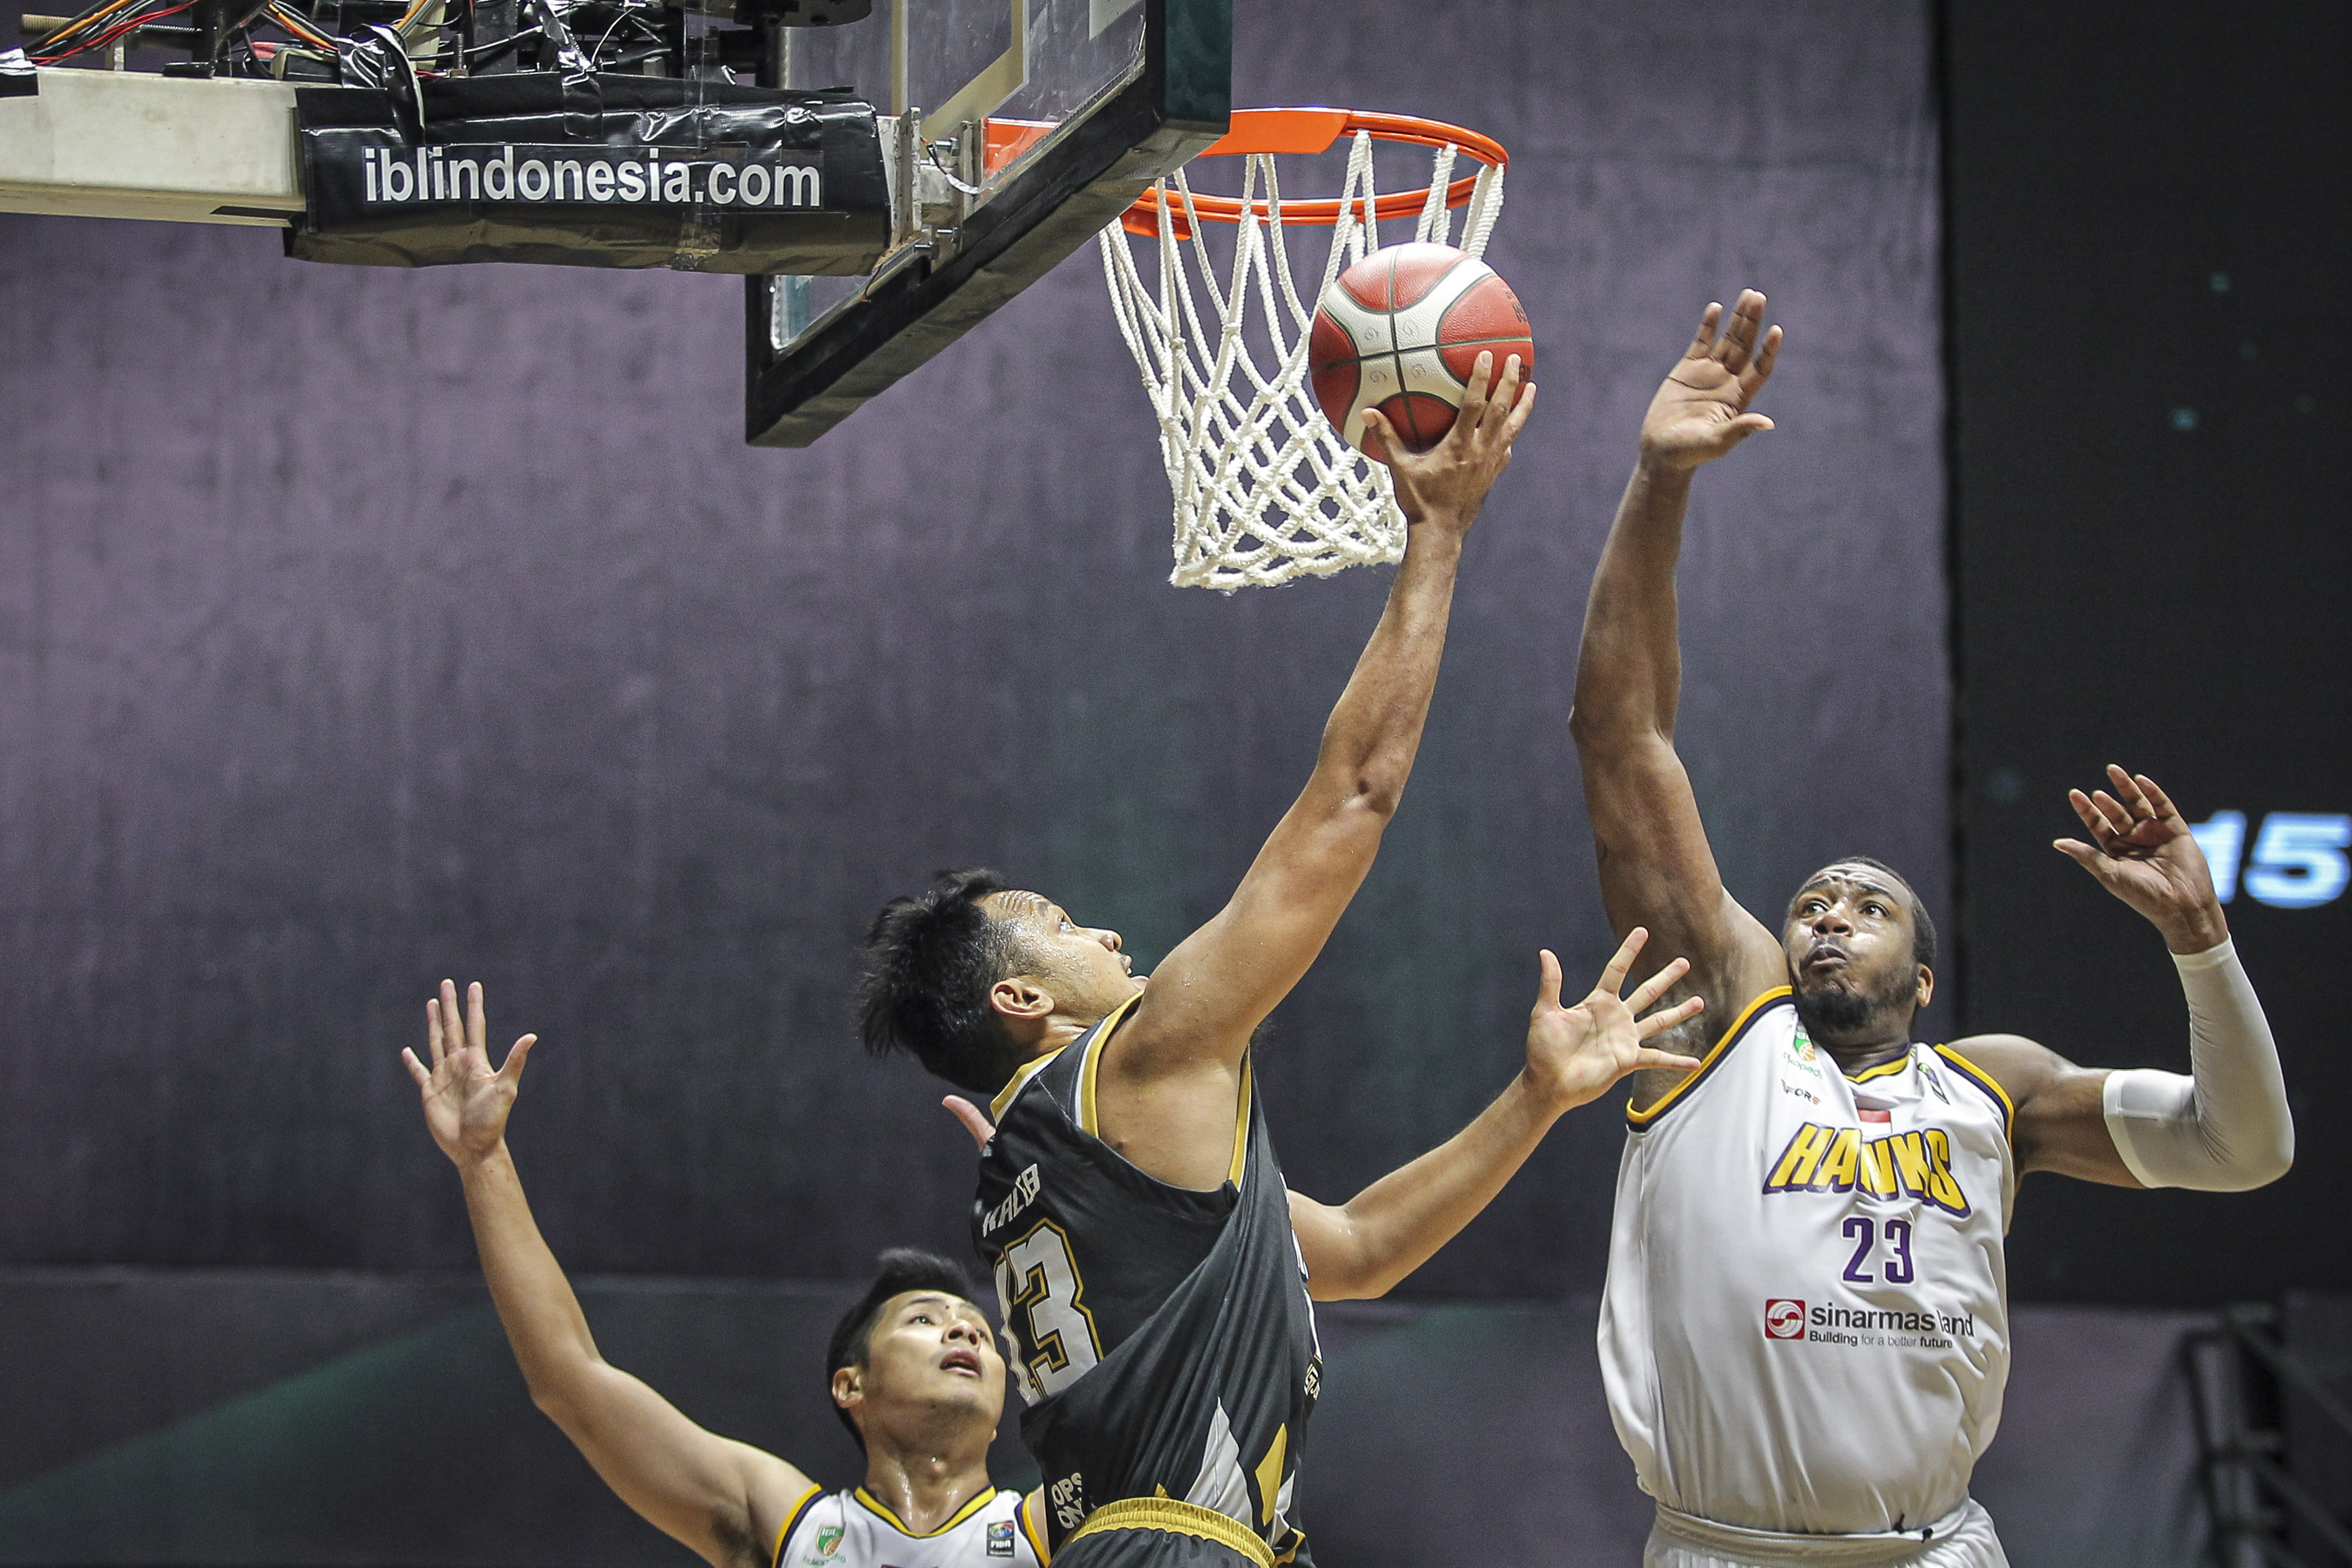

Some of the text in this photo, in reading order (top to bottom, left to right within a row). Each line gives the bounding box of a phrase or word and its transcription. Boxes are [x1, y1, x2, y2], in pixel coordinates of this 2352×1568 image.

[365, 145, 820, 207] iblindonesia.com
[2189, 809, 2351, 909] 15
[1843, 1217, 1915, 1283] 23
[995, 1218, 1104, 1407] 13
[1809, 1330, 1858, 1347] Building
[1861, 1333, 1875, 1345] for
[1877, 1338, 1885, 1346] a
[1920, 1335, 1953, 1348] future
[1810, 1302, 1975, 1338] sinarmas land
